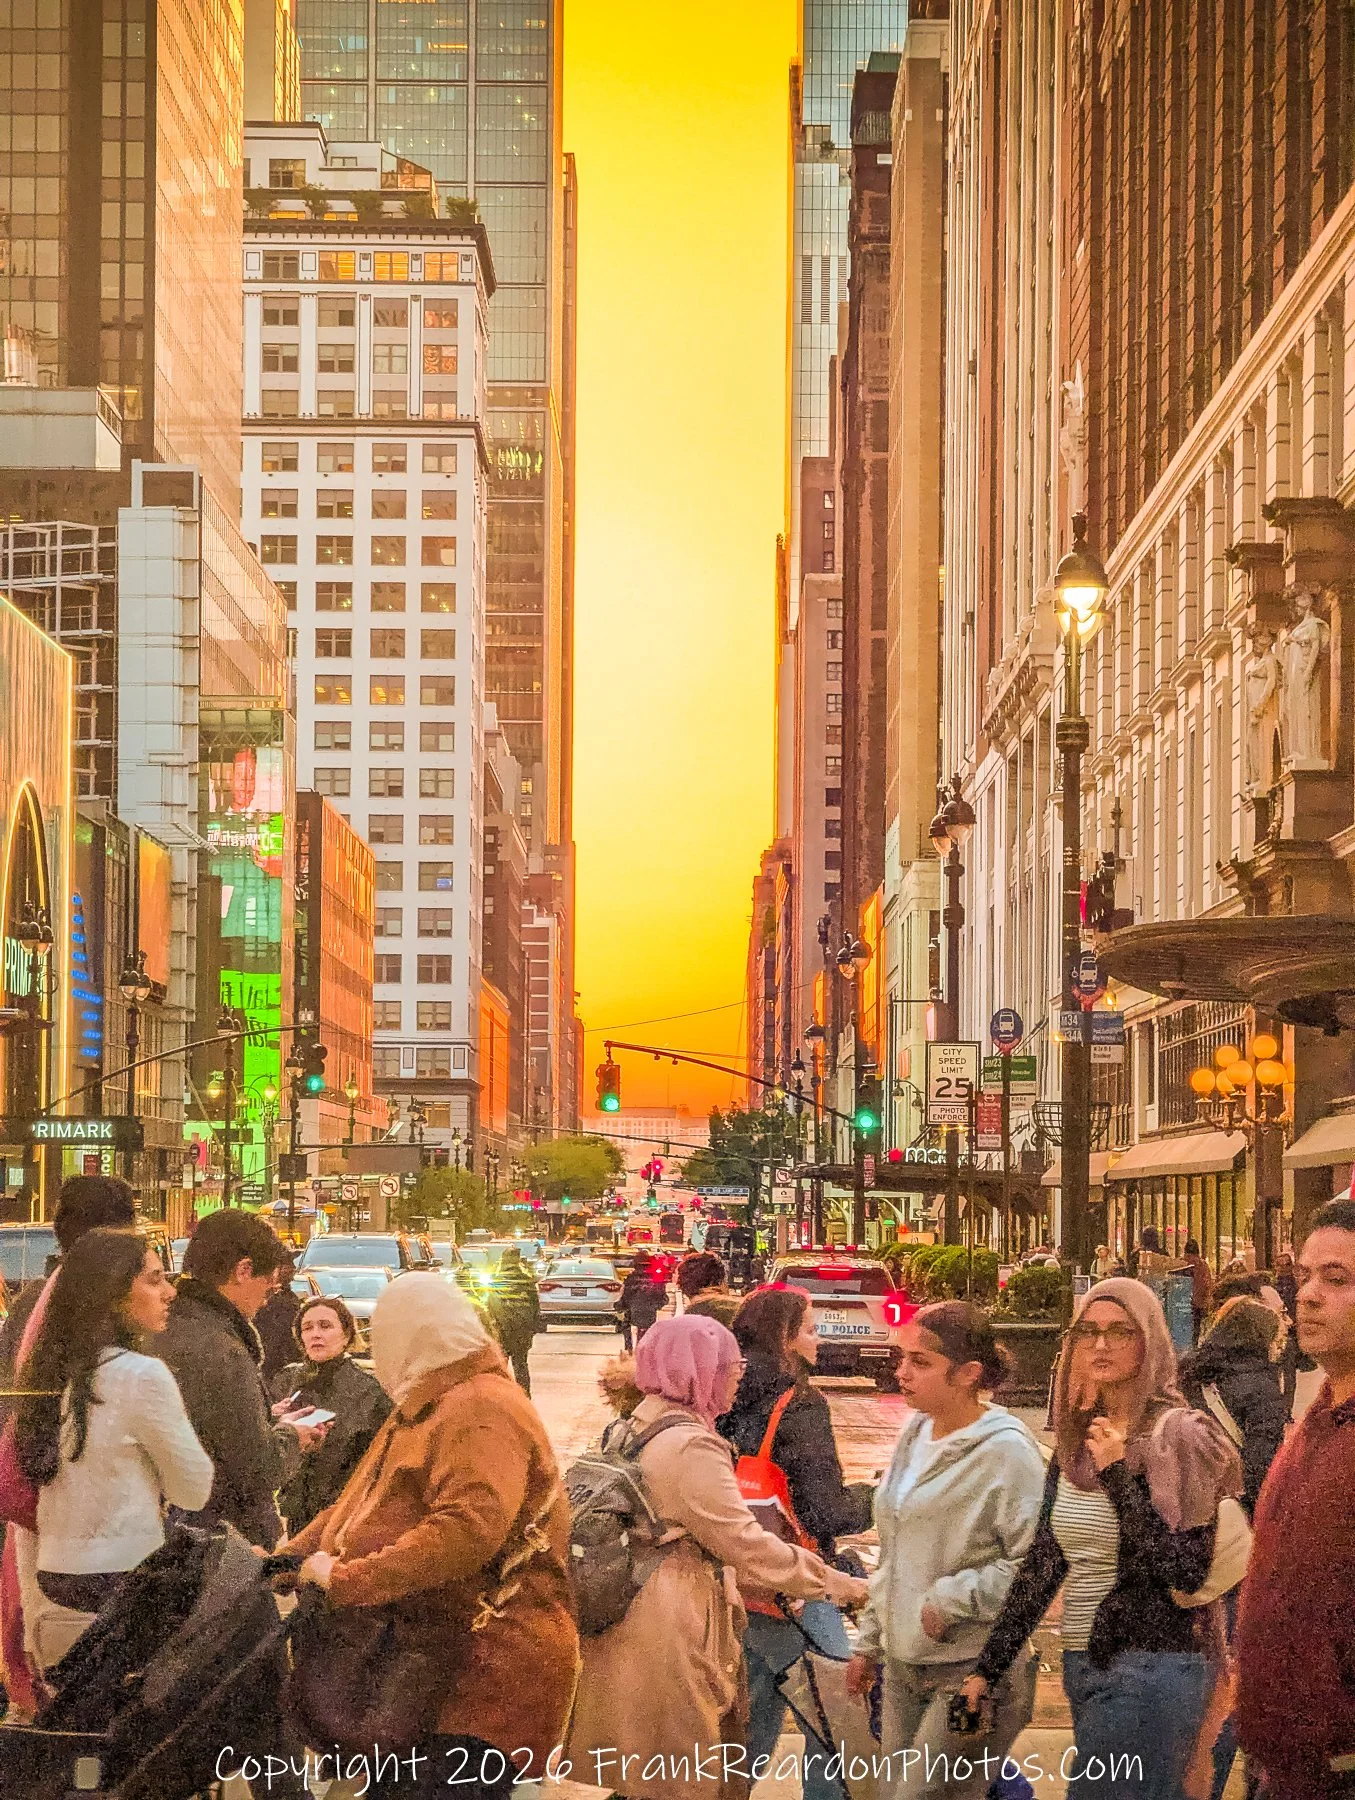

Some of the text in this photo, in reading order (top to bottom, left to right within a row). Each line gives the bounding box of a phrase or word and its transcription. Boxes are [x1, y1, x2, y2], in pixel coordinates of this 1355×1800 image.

[942, 1048, 963, 1056] CITY
[938, 1057, 967, 1065] SPEED
[941, 1066, 964, 1074] LIMIT
[935, 1077, 970, 1099] 25
[832, 1325, 871, 1335] POLICE
